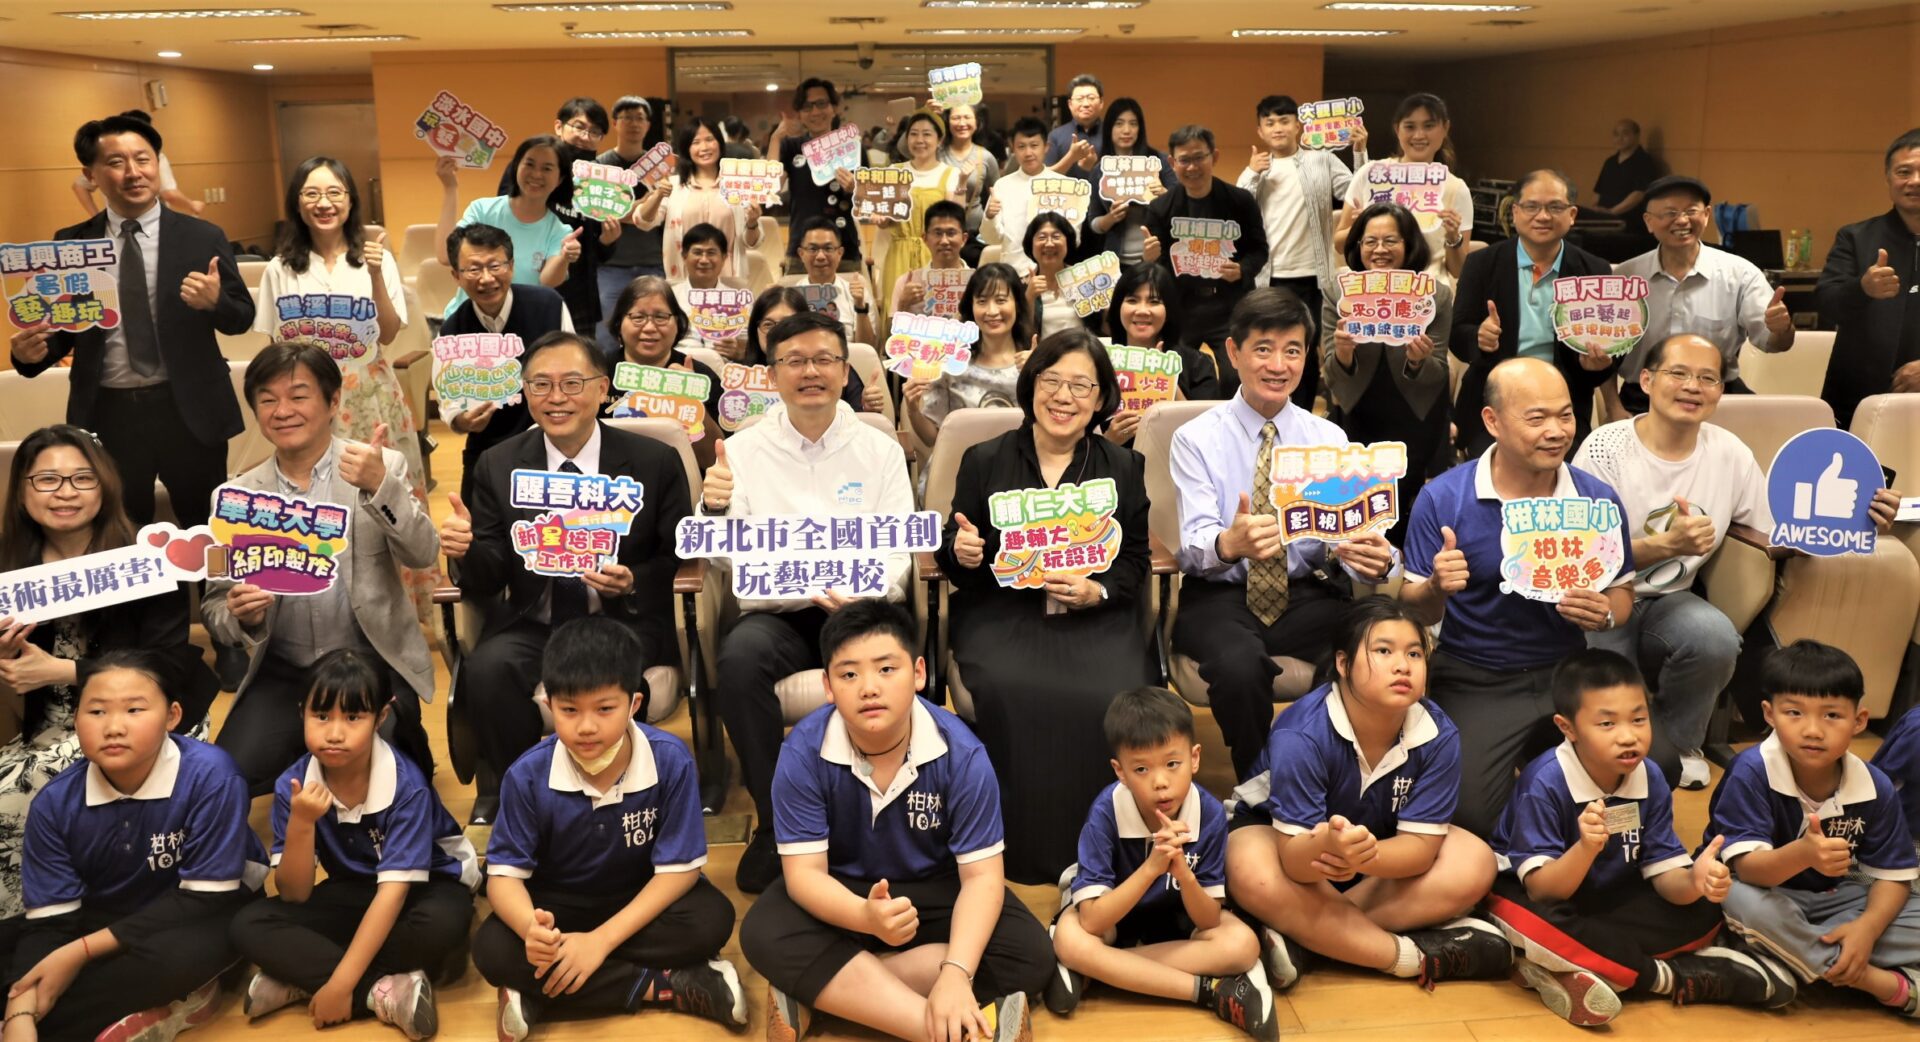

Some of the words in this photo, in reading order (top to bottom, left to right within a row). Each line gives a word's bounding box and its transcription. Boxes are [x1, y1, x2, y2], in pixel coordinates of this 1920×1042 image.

[433, 92, 506, 148] 淡水國中
[1299, 99, 1364, 121] 大觀國小
[856, 168, 914, 185] 中和國小
[1369, 163, 1447, 185] 永和國中
[866, 186, 895, 199] 一起
[1173, 218, 1240, 240] 頂埔國小
[0, 241, 117, 273] 復興商工
[35, 272, 90, 295] 暑假
[1340, 271, 1435, 297] 吉慶國小
[1555, 276, 1649, 304] 屈尺國小
[277, 294, 377, 321] 雙溪國小
[435, 334, 523, 361] 牡丹國小
[616, 366, 708, 401] 莊敬高職
[1139, 376, 1169, 392] 少年
[635, 396, 675, 415] FUN
[678, 404, 697, 422] 假
[1274, 444, 1406, 484] 康寧大學
[513, 474, 642, 512] 醒吾科大
[991, 481, 1117, 527] 輔仁大學
[216, 488, 347, 540] 華梵大學
[1290, 493, 1390, 531] 影視動畫
[1505, 499, 1621, 534] 柑林國小
[517, 526, 617, 551] 新星培育
[679, 514, 938, 554] 新北市全國首創
[1775, 522, 1874, 551] AWESOME
[232, 544, 335, 578] 絹印製作
[539, 551, 594, 569] 工作坊
[1042, 543, 1107, 569] 玩設計
[736, 558, 886, 597] 玩藝學校
[1532, 557, 1605, 590] 音樂會
[906, 790, 942, 813] 柑林
[907, 811, 942, 831] 104
